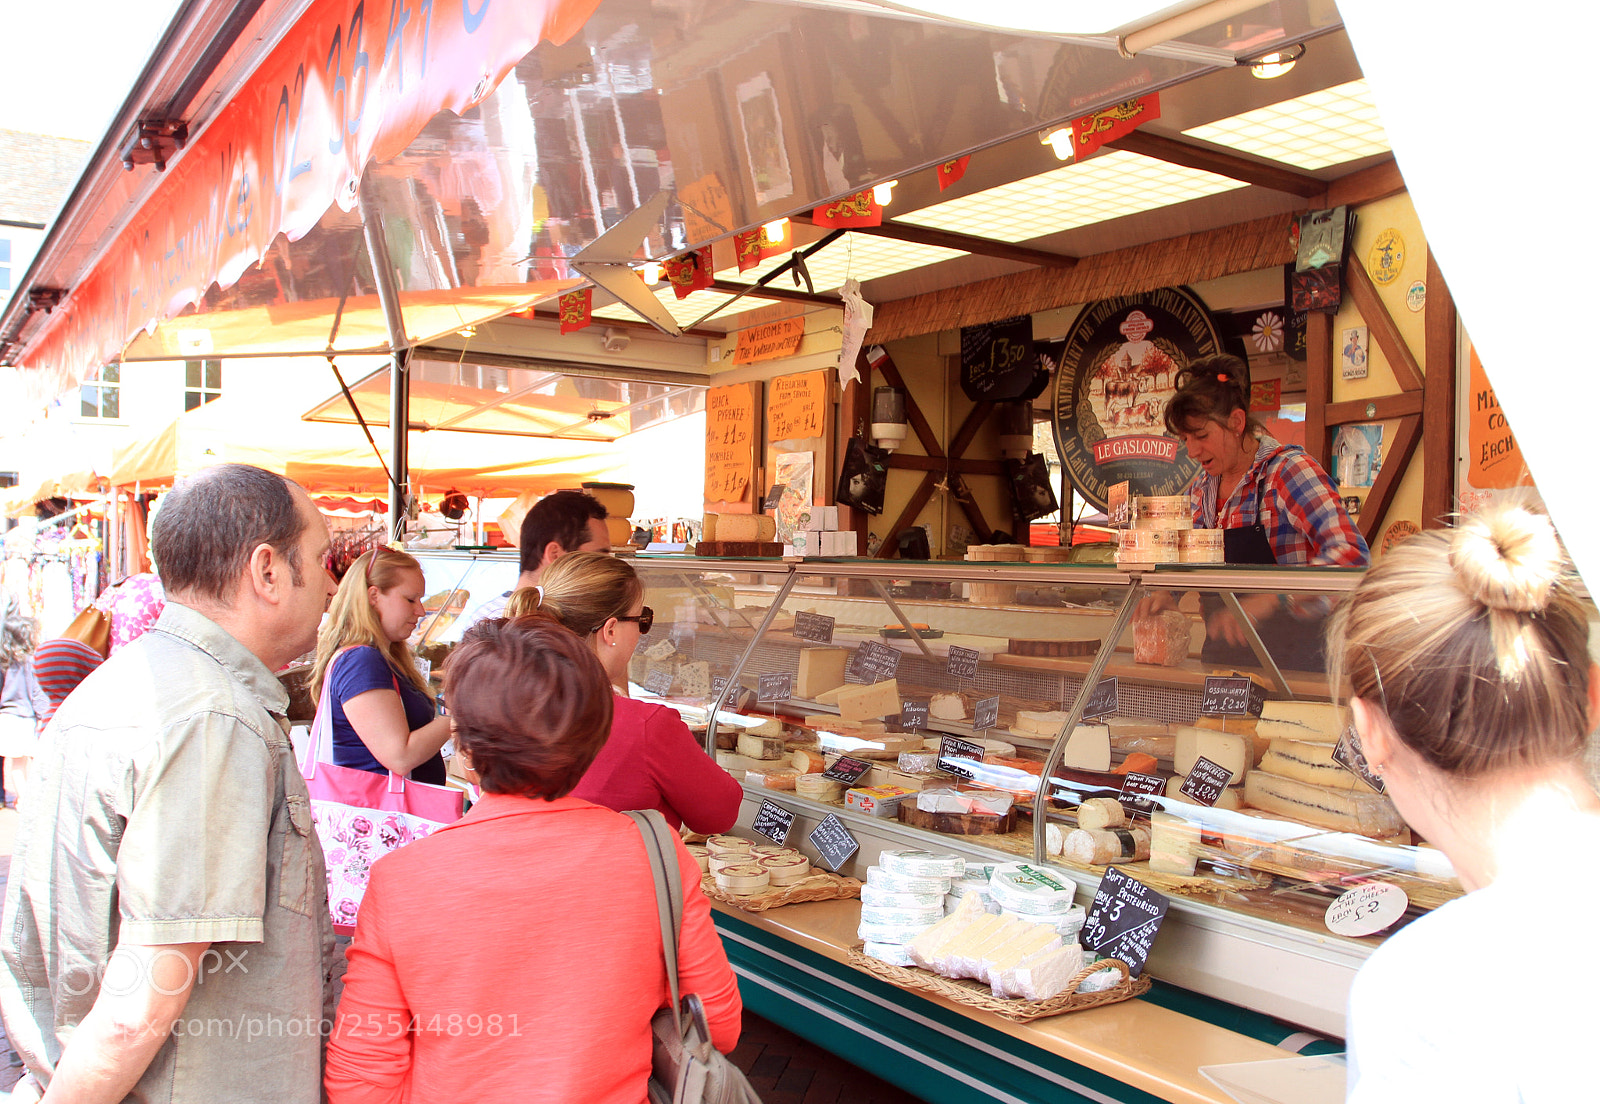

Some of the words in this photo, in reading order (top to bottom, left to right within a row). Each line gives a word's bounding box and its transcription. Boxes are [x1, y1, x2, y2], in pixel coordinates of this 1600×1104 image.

[273, 62, 312, 197] 02
[326, 2, 369, 155] 33
[1078, 327, 1096, 343] DE
[1152, 287, 1210, 344] APPELLATION
[747, 323, 782, 343] WELCOME
[784, 321, 792, 332] TO
[1098, 443, 1112, 459] LE
[1112, 439, 1174, 458] GASLONDE
[1480, 434, 1514, 465] EACH
[1069, 449, 1087, 473] Lait
[1081, 467, 1098, 491] Cru
[1197, 761, 1226, 780] MANCHEGO
[1332, 898, 1356, 910] THE
[1359, 888, 1389, 903] CHEESE
[1337, 891, 1358, 903] CUT
[1331, 908, 1352, 924] EACH
[1085, 924, 1106, 947] £2
[1110, 946, 1118, 958] 2
[1119, 942, 1130, 952] FOR
